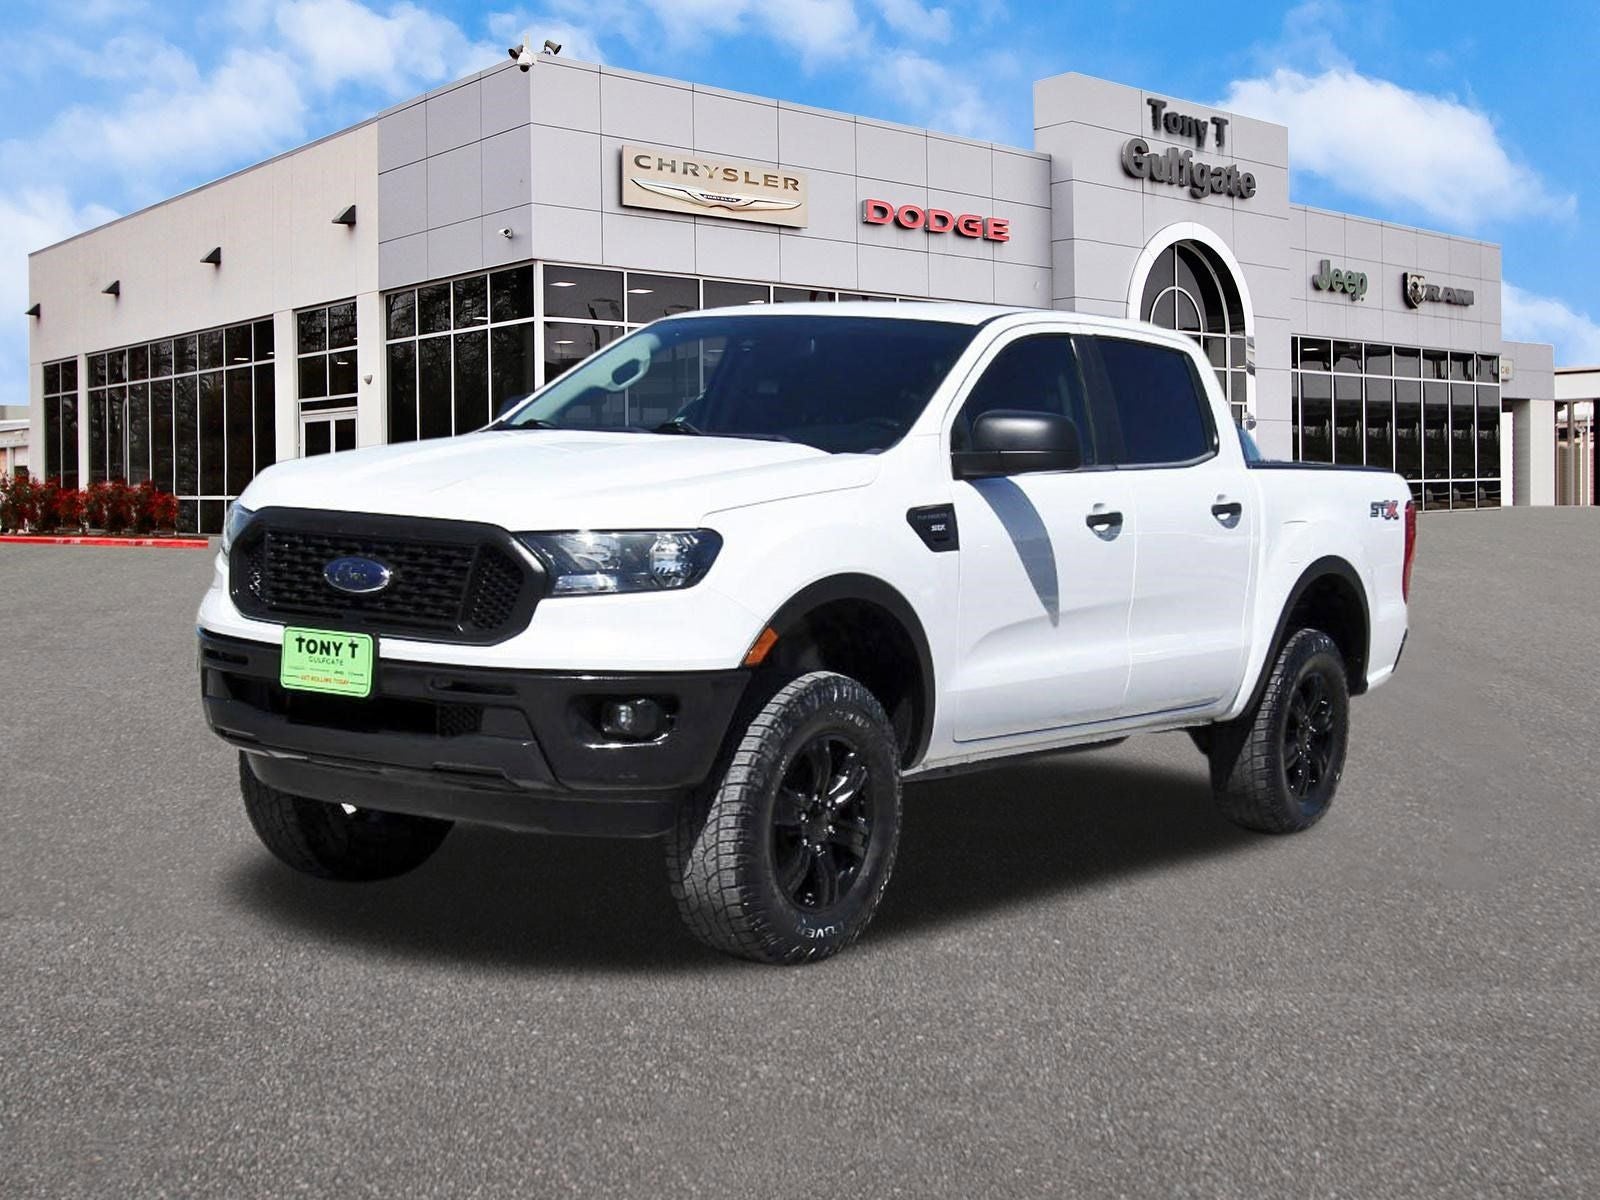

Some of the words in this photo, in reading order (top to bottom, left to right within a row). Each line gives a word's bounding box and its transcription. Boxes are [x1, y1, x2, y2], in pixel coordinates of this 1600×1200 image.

[1146, 98, 1208, 148] Tony
[1210, 116, 1229, 148] T
[634, 154, 800, 192] CHRYSLER
[1121, 138, 1257, 199] Gulfgate
[862, 198, 1010, 242] DODGE
[1312, 259, 1368, 302] Jeep
[1425, 284, 1475, 306] RAM
[1370, 500, 1400, 520] STX
[295, 634, 343, 657] TONY
[348, 639, 359, 659] T
